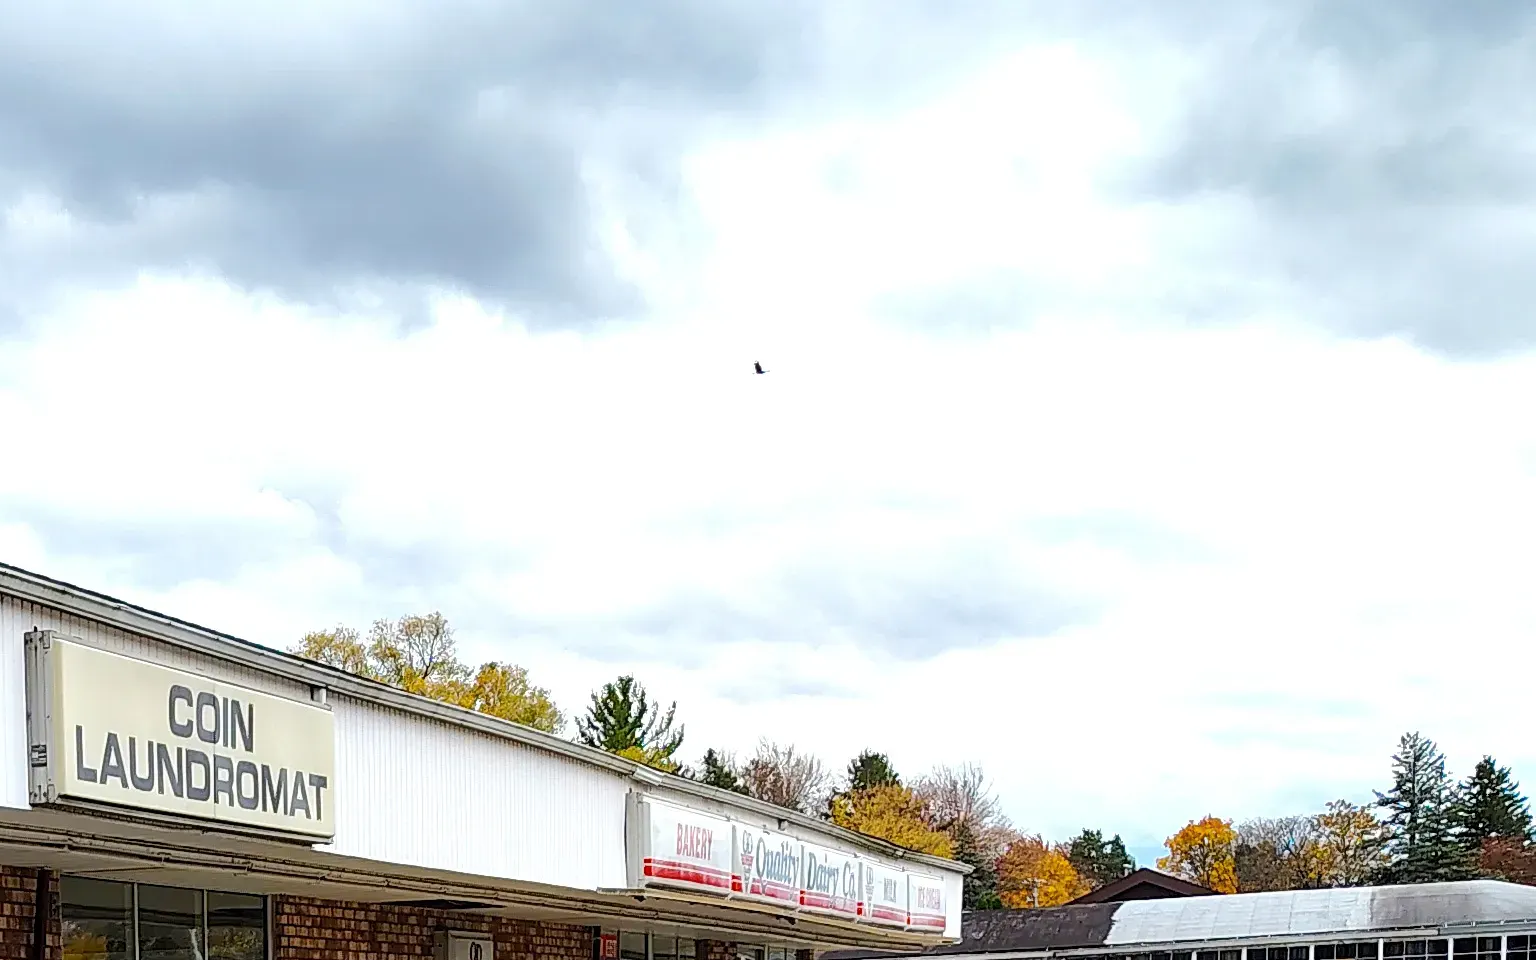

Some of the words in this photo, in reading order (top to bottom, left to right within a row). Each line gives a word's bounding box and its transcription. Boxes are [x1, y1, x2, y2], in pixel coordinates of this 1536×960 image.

[168, 684, 254, 752] COIN
[76, 725, 328, 821] LAUNDROMAT
[676, 822, 713, 861] BAKERY
[755, 837, 800, 900] Quality
[806, 852, 839, 907] Dairy
